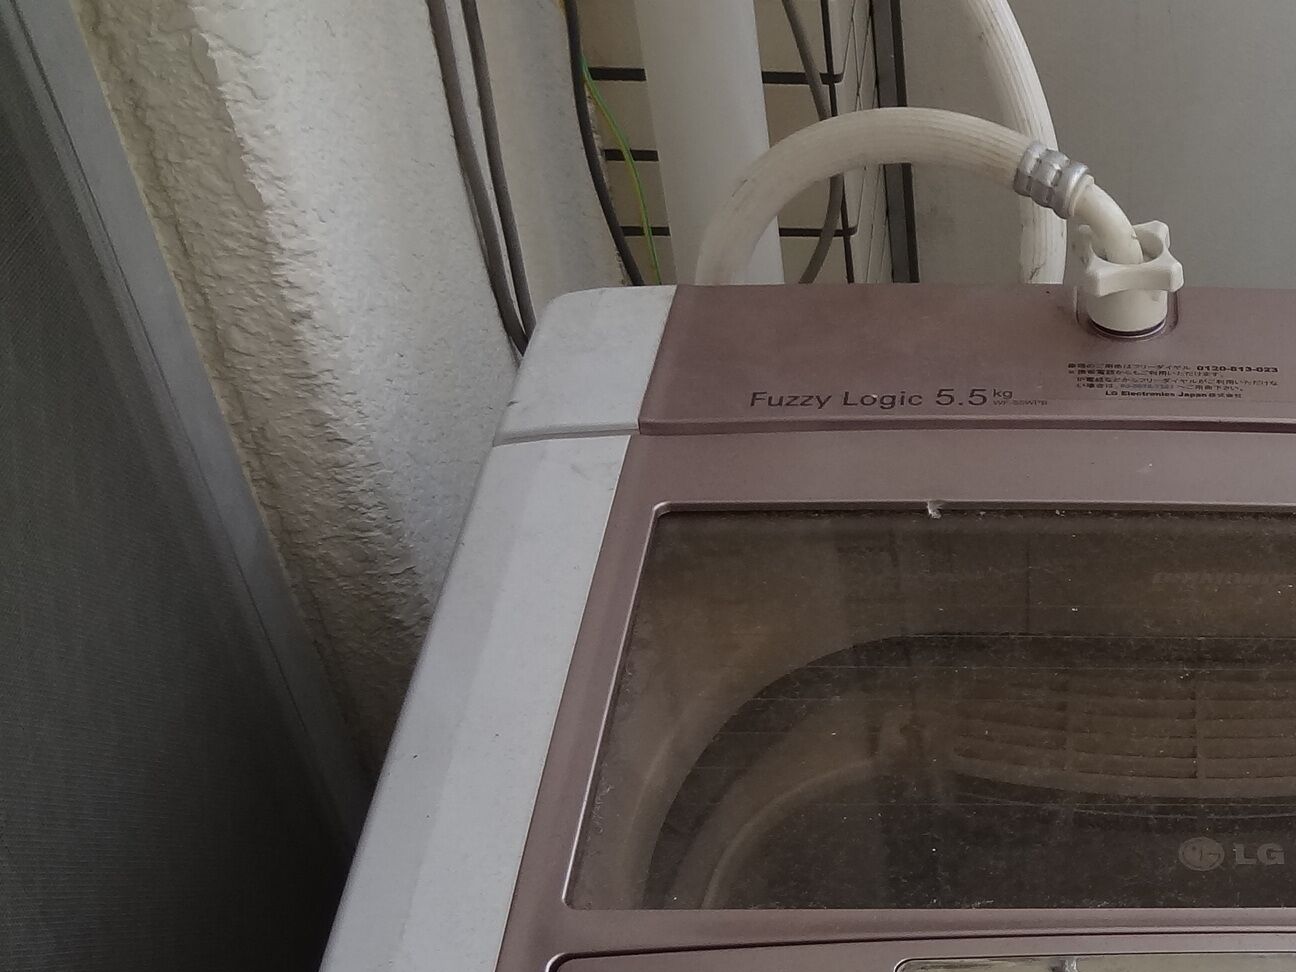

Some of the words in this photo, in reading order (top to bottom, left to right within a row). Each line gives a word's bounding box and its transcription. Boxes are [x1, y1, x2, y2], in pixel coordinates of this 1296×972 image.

[749, 391, 832, 410] Fuzzy
[842, 391, 923, 410] Logic
[935, 388, 988, 406] 5.5
[993, 388, 1013, 400] kg
[1121, 390, 1176, 398] Electronics
[1233, 842, 1286, 866] LG
